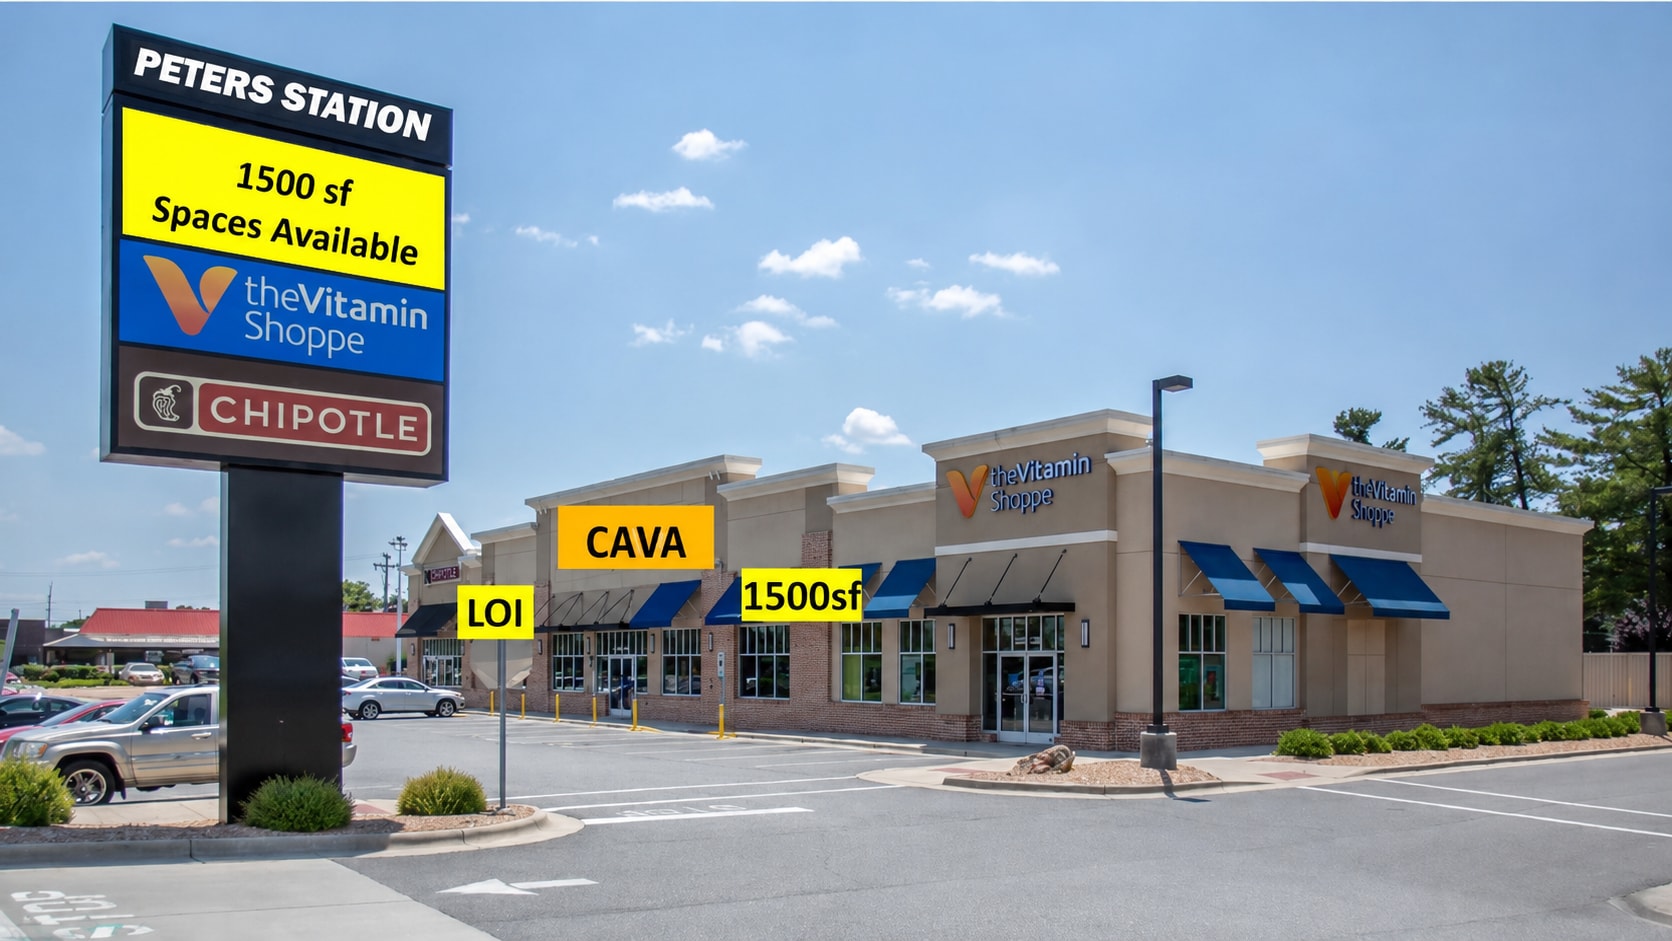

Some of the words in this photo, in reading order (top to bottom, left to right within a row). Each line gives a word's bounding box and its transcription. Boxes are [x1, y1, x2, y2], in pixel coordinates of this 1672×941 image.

[133, 47, 275, 105] PETERS
[280, 82, 433, 142] STATION
[236, 162, 315, 200] 1500
[323, 178, 354, 207] sf
[152, 196, 262, 239] Spaces
[270, 217, 419, 266] Available
[245, 275, 428, 330] theVitamin
[245, 310, 365, 359] Shoppe
[210, 396, 419, 443] CHIPOTLE
[990, 452, 1092, 488] theVitamin
[1351, 476, 1417, 506] theVitamin
[990, 488, 1054, 514] Shoppe
[1351, 499, 1396, 528] Shoppe
